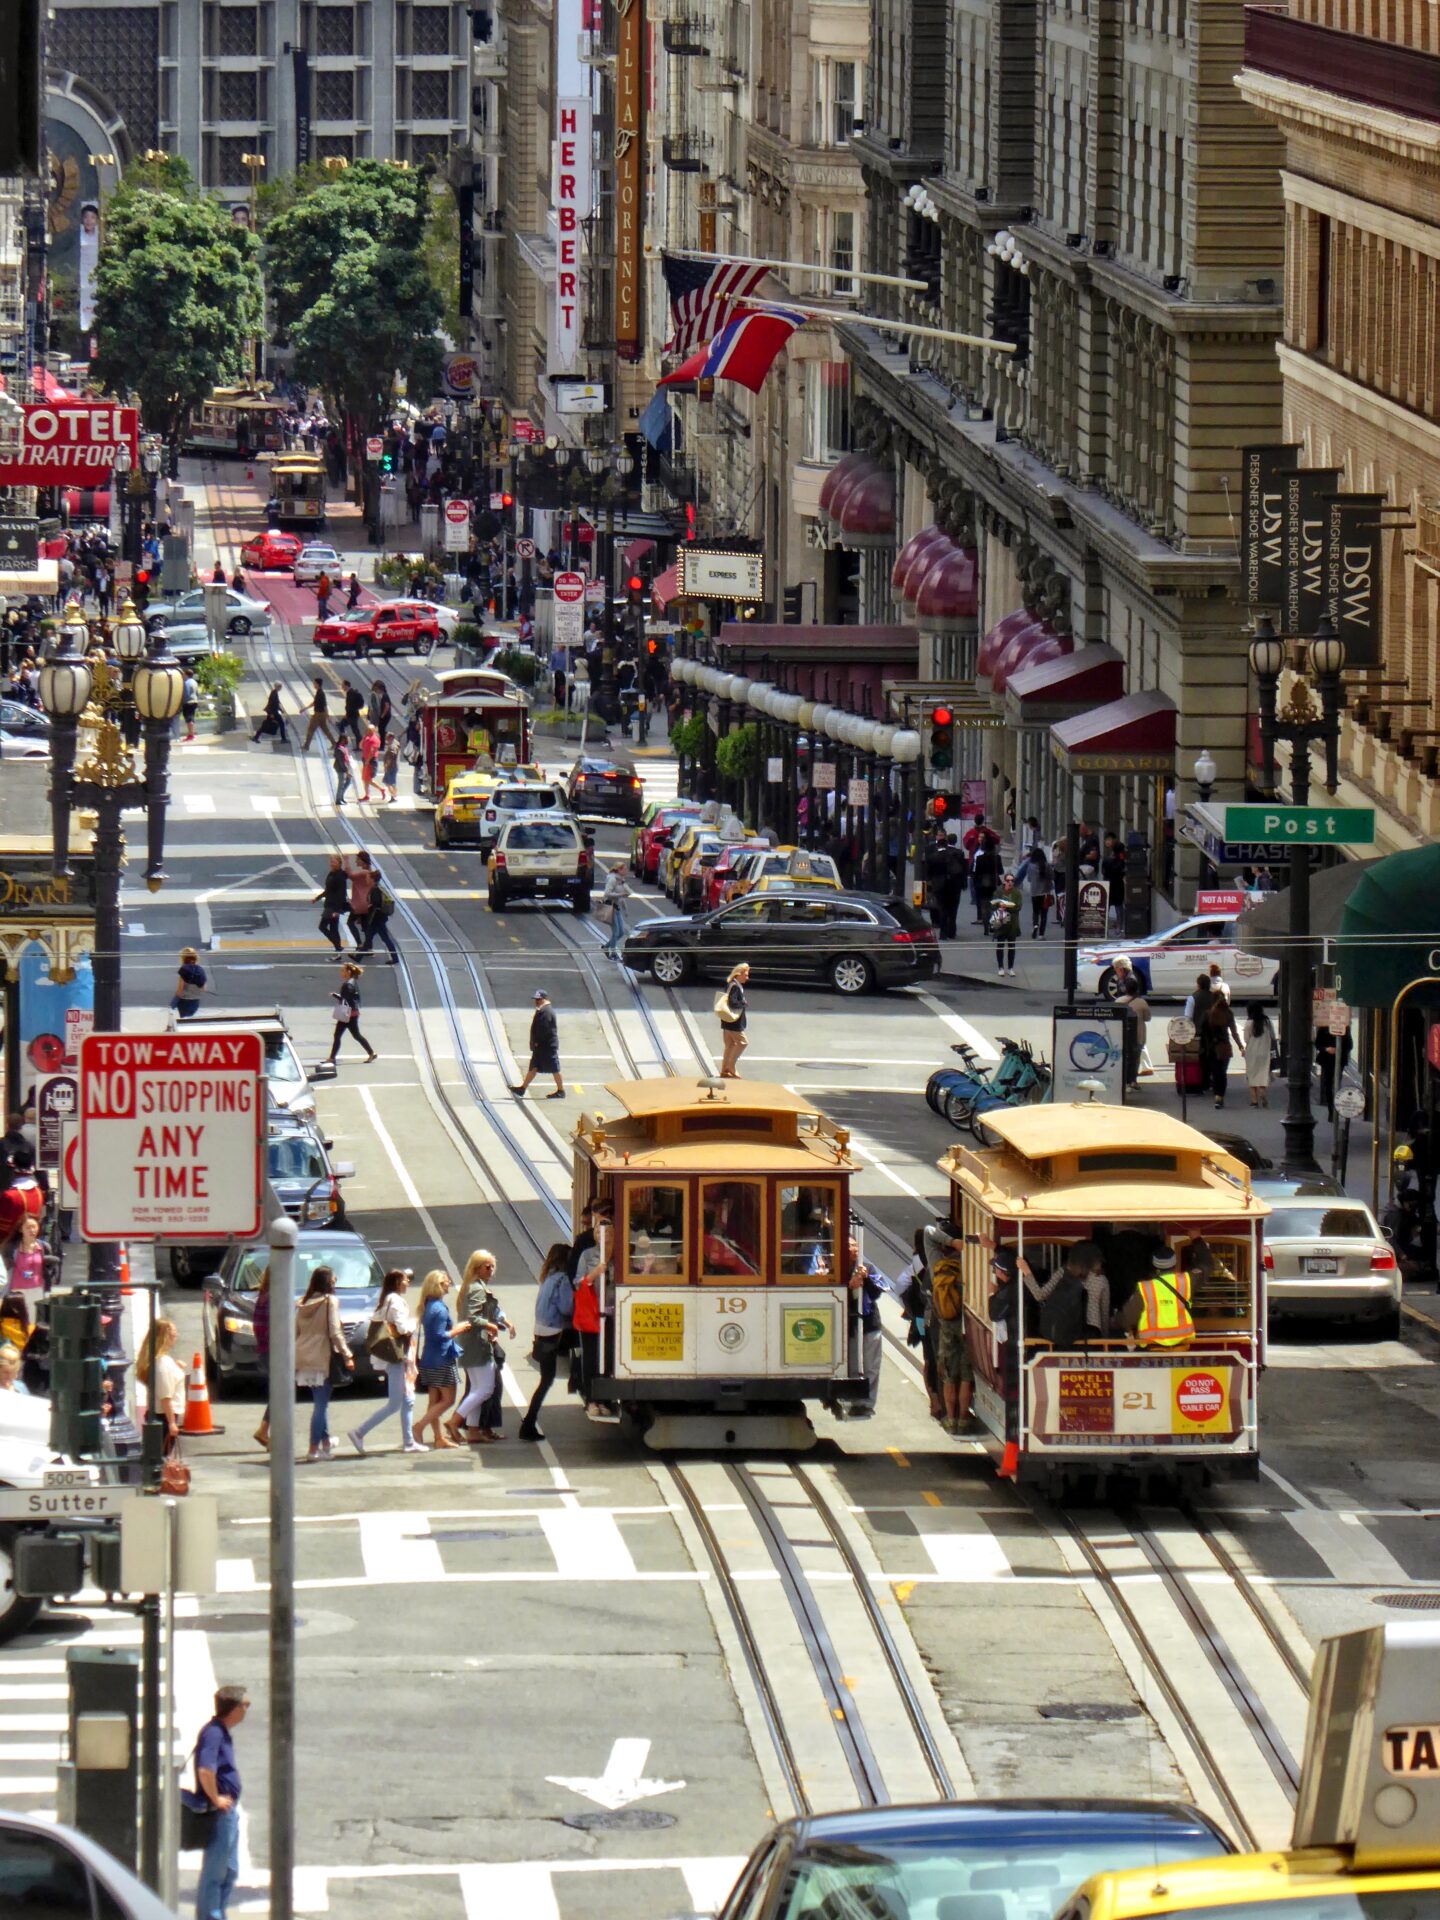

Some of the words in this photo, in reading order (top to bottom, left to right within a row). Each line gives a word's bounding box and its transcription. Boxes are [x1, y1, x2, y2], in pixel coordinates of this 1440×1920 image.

[559, 108, 577, 330] HERBERT
[614, 128, 638, 329] FLORENCE
[27, 408, 132, 442] OTEL
[0, 444, 117, 467] STRATFOR
[1249, 453, 1261, 507] DESIGNER
[1287, 479, 1300, 534] DESIGNER
[1249, 508, 1260, 539] SHOE
[1262, 492, 1283, 567] DSW
[1329, 503, 1342, 561] DESIGNER
[1287, 536, 1299, 566] SHOE
[1302, 518, 1324, 595] DSW
[708, 570, 737, 580] EXPRESS
[1328, 562, 1340, 594] SHOE
[1342, 544, 1372, 628] DSW
[1077, 757, 1170, 769] GOYARD
[1264, 815, 1336, 835] Post
[1223, 843, 1291, 860] CHASE
[1202, 895, 1216, 904] NOT
[1217, 895, 1222, 904] A
[66, 1011, 80, 1022] NO
[97, 1042, 244, 1065] TOW-AWAY
[87, 1070, 131, 1114] NO
[141, 1080, 251, 1114] STOPPING
[137, 1126, 206, 1158] ANY
[133, 1165, 209, 1199] TIME
[634, 1307, 681, 1316] POWELL
[715, 1297, 748, 1314] 19
[633, 1320, 681, 1329] MARKET
[1057, 1357, 1123, 1369] MARKET
[1060, 1374, 1112, 1383] POWELL
[1185, 1379, 1197, 1388] DO
[1198, 1379, 1216, 1387] NOT
[1060, 1388, 1113, 1397] MARKET
[1190, 1386, 1211, 1394] PASS
[1122, 1392, 1156, 1410] 21
[1181, 1403, 1204, 1412] CABLE
[1205, 1403, 1220, 1411] CAR
[47, 1473, 74, 1485] 500
[28, 1495, 108, 1512] Sutter
[1386, 1731, 1440, 1771] TA
